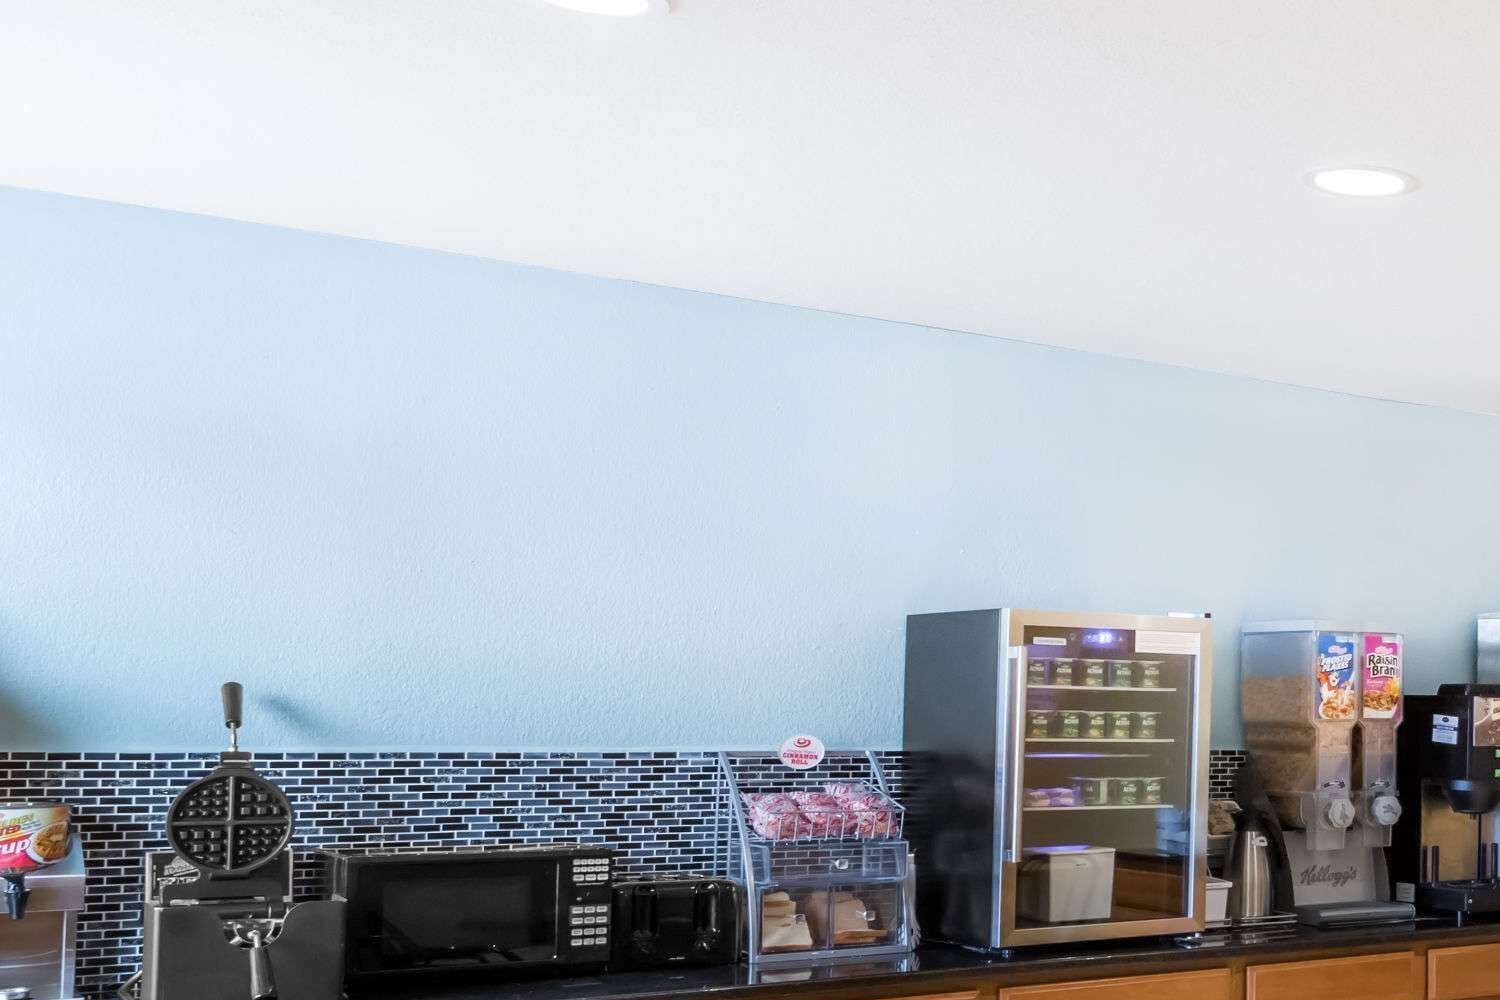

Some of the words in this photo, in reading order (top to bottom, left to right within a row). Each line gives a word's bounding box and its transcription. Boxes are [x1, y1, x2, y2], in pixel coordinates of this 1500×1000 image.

[1368, 654, 1398, 667] Raisin
[1372, 665, 1396, 676] Bran
[0, 838, 30, 855] up
